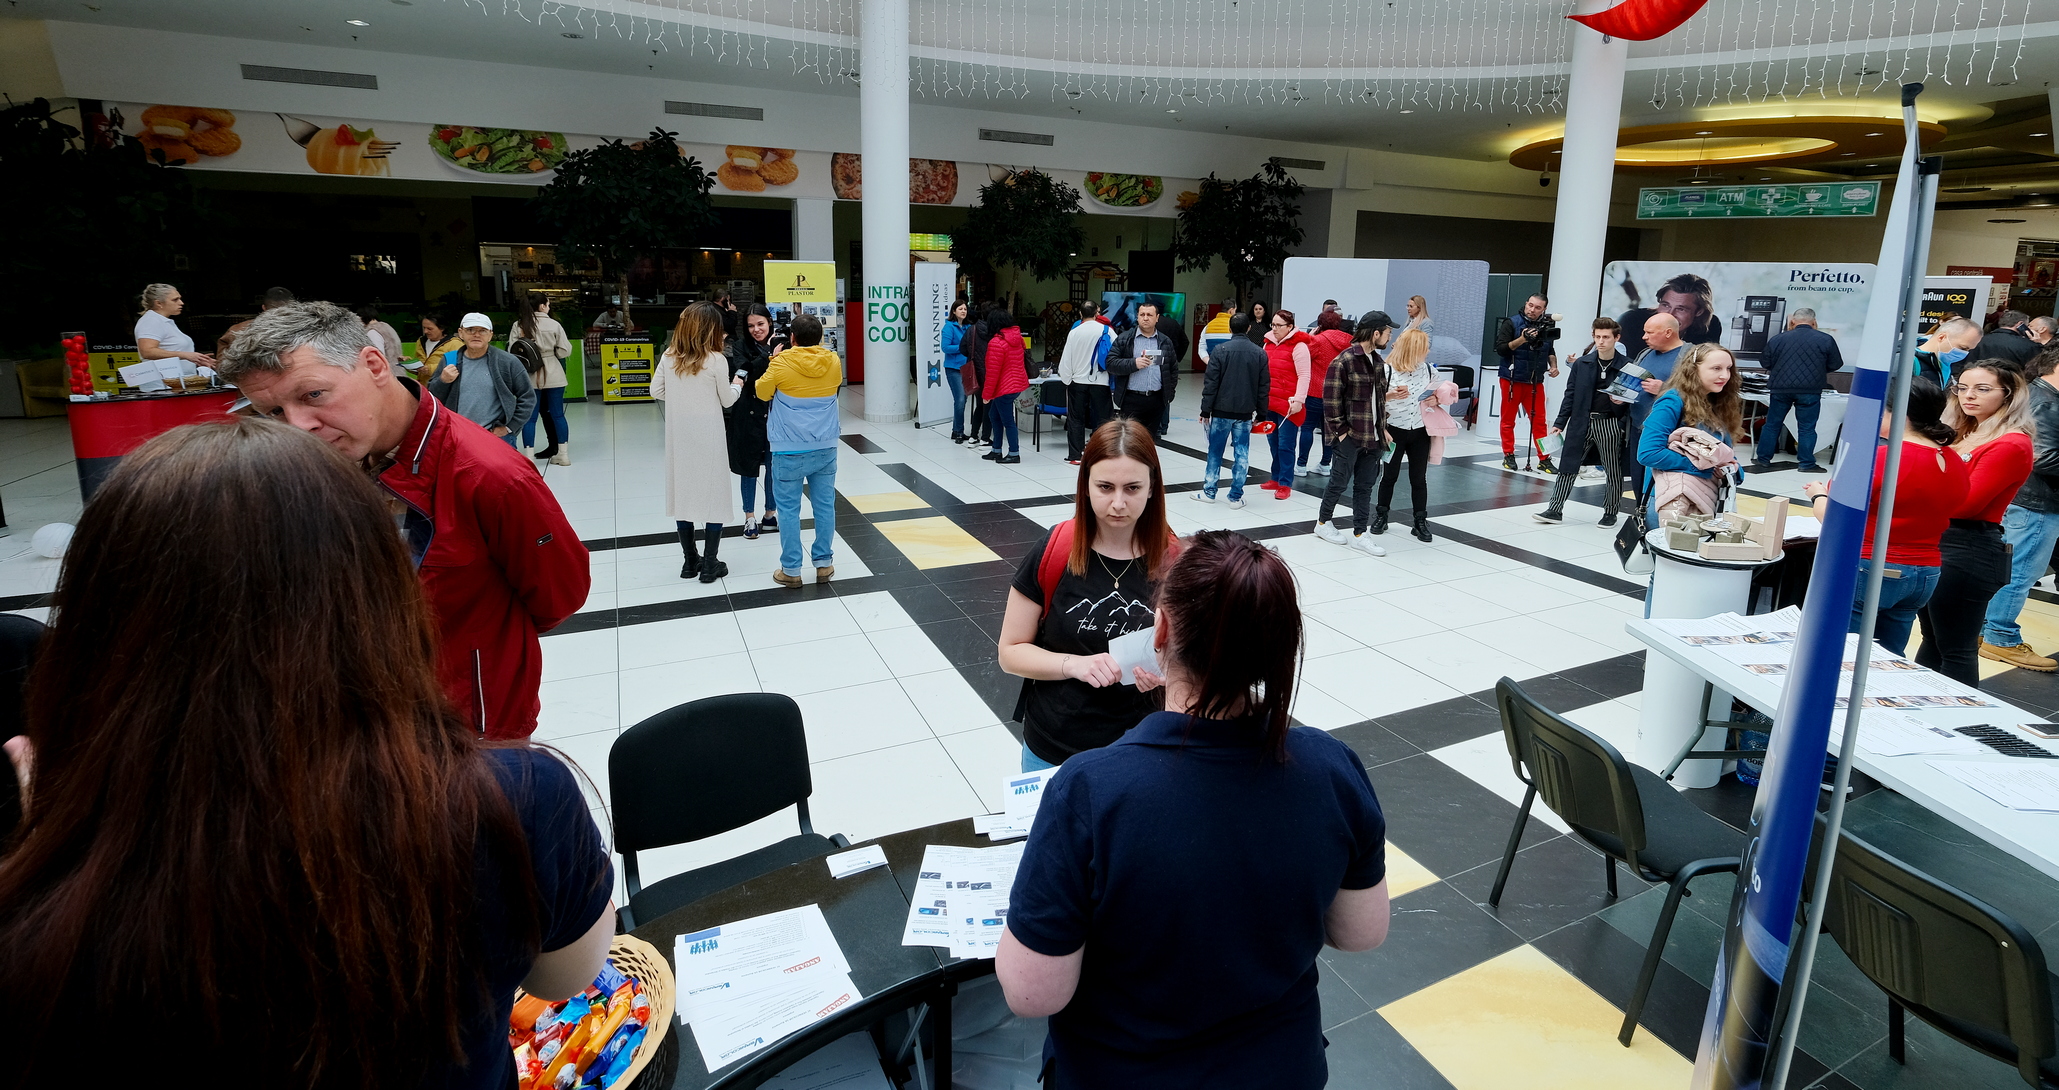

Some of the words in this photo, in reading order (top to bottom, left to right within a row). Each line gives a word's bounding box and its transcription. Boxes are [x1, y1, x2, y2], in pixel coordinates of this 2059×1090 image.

[1717, 193, 1743, 202] ATM
[796, 275, 806, 286] P
[1789, 269, 1865, 284] Perfetto,
[868, 285, 910, 299] INTRA
[1922, 291, 1945, 302] RAUN
[1946, 293, 1968, 302] 100
[931, 283, 941, 354] HANNING
[1076, 616, 1099, 634] take
[1104, 620, 1119, 638] it
[783, 956, 821, 974] ANGAJAM
[816, 992, 851, 1018] ANGAJAM
